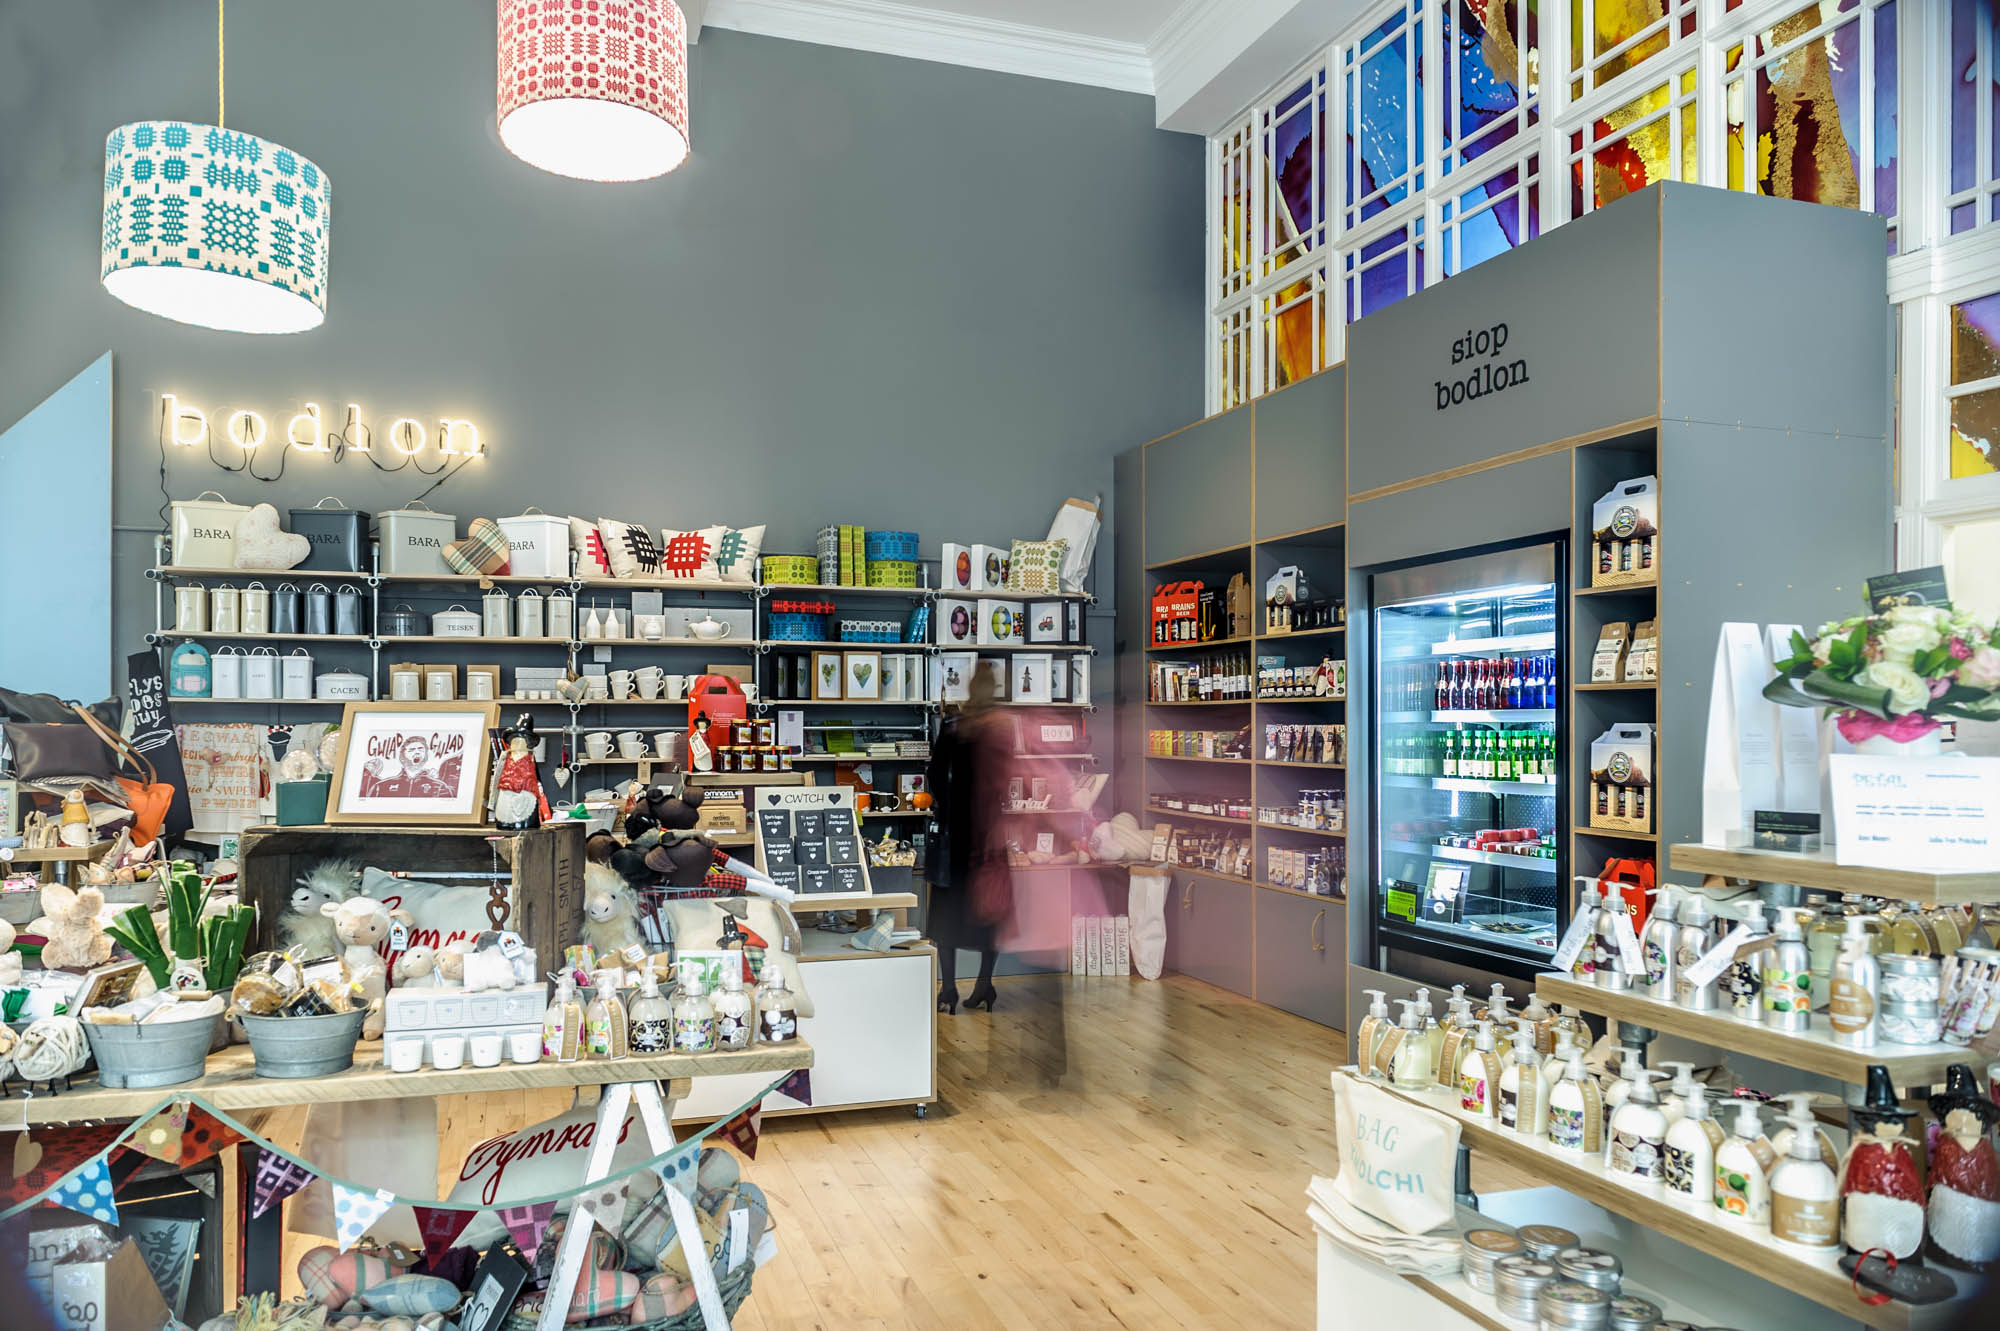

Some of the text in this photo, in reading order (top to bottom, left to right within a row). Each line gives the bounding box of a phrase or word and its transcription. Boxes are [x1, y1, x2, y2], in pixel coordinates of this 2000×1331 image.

[1452, 323, 1508, 365] siop
[1434, 360, 1529, 410] bodlon
[161, 393, 485, 458] bodlon
[193, 528, 232, 540] BARA
[306, 534, 341, 545] BARA
[408, 536, 441, 548] BARA
[509, 541, 535, 551] BARA
[1171, 602, 1195, 611] BRAINS
[330, 687, 360, 695] CACEN
[368, 732, 464, 760] GWLAD GWLAD
[785, 793, 824, 804] CWTCH
[560, 858, 569, 909] SMITH
[1356, 1112, 1400, 1152] BAG
[459, 1116, 635, 1206] Cymras
